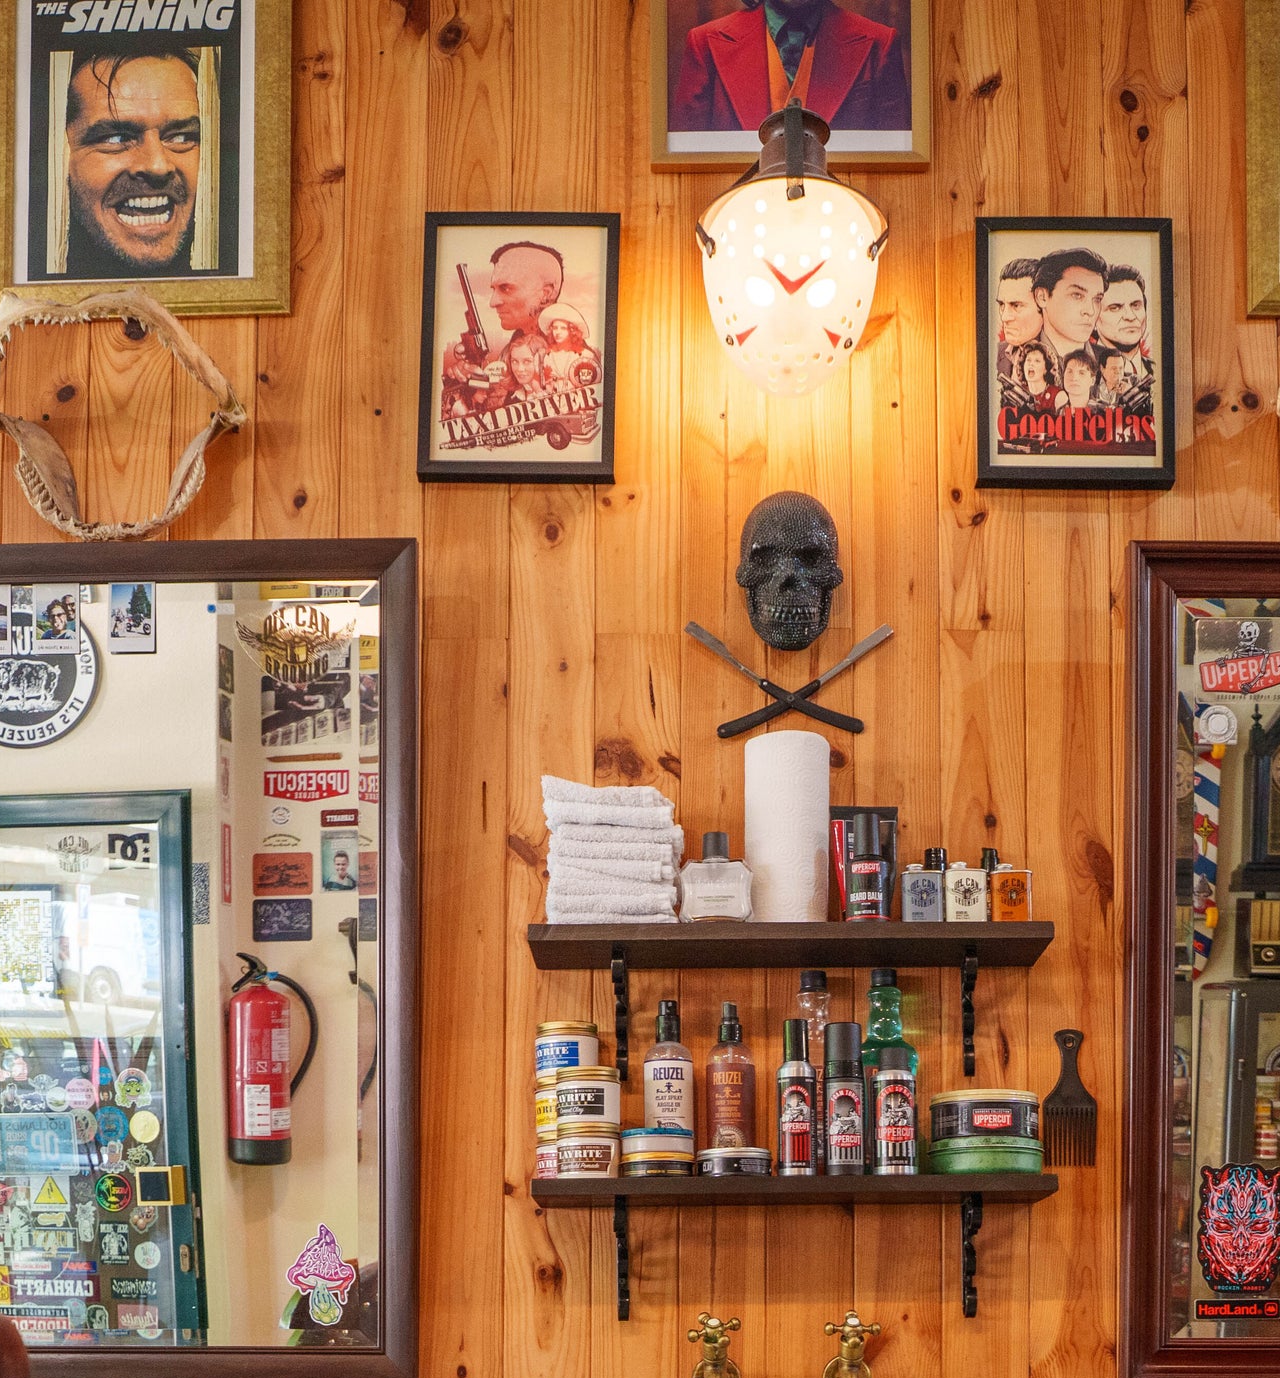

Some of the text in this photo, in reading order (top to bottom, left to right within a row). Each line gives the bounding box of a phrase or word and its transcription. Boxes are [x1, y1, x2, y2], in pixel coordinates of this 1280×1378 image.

[35, 3, 68, 17] THE
[442, 386, 600, 443] TAXI DRIVER
[263, 604, 331, 641] OIL CAN
[264, 652, 330, 684] GROOMING
[851, 863, 881, 872] UPPERCUT
[865, 891, 883, 901] BALM
[652, 1067, 685, 1081] REUZEL
[712, 1071, 743, 1085] REUZEL
[973, 1114, 1012, 1125] UPPERCUT
[782, 1122, 811, 1131] UPPERCUT
[878, 1127, 915, 1137] UPPERCUT
[830, 1135, 861, 1145] UPPERCUT
[558, 1150, 603, 1159] LAYRITE
[1198, 1304, 1259, 1315] HardLand
